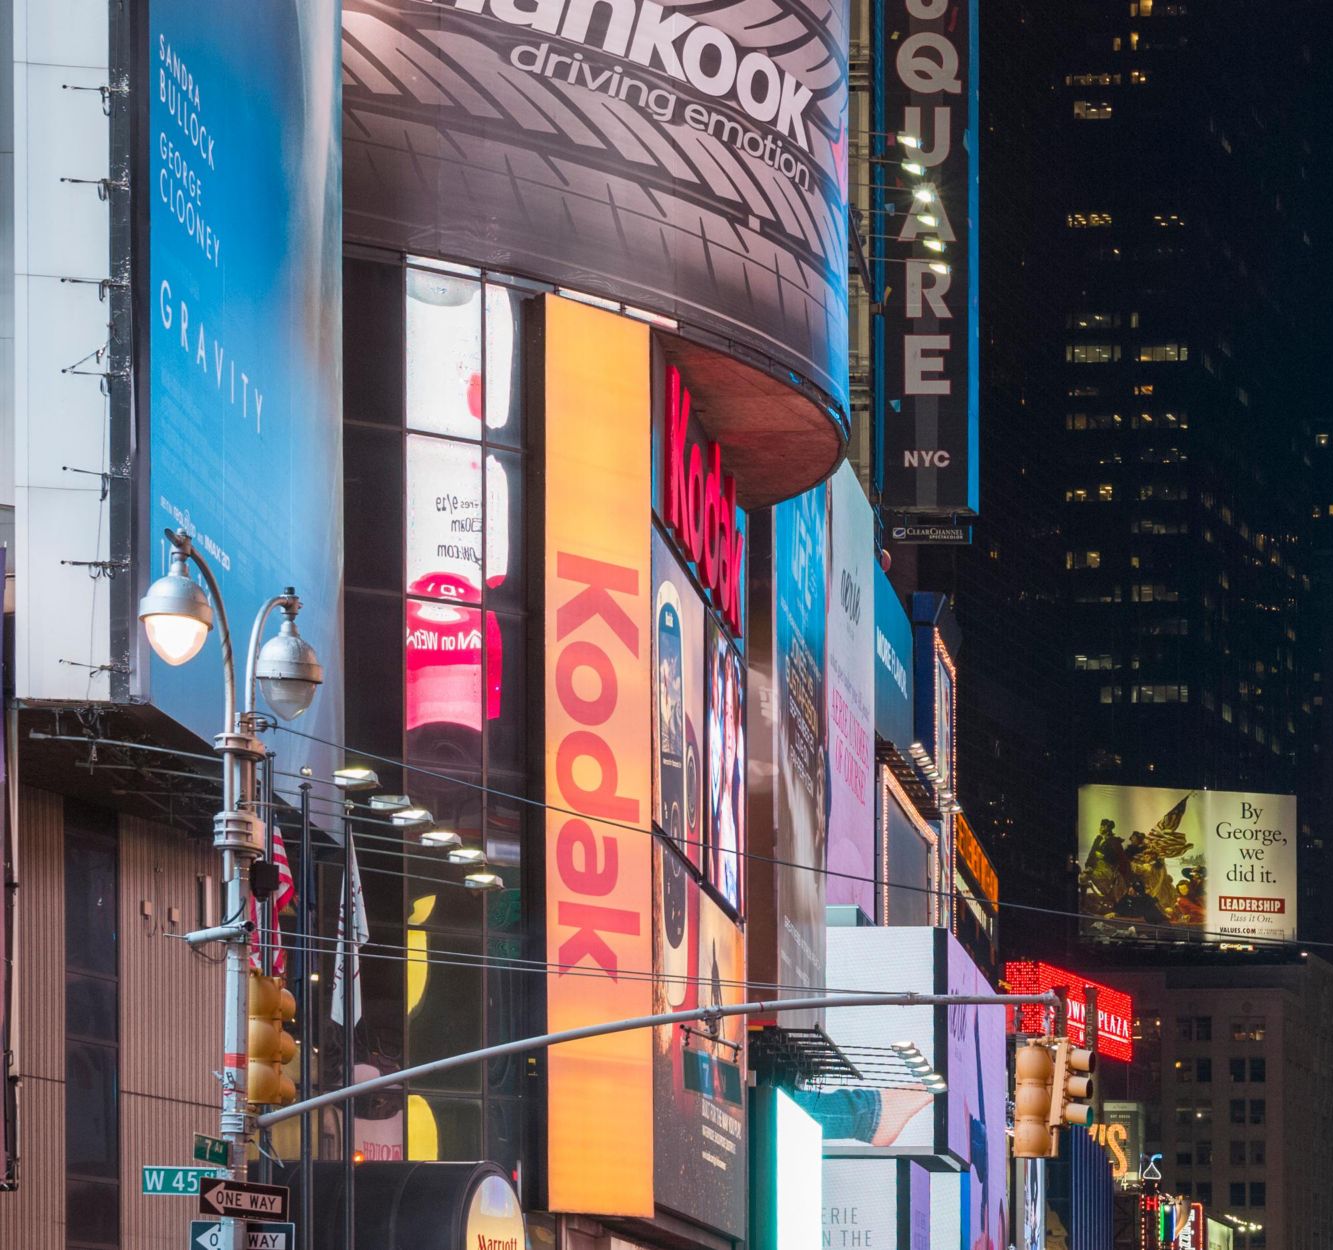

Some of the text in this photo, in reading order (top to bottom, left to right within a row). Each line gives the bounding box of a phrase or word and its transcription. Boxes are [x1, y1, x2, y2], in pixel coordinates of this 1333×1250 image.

[159, 33, 201, 111] SANDRA
[159, 68, 215, 171] BULLOCK
[510, 43, 811, 192] driving emotion
[159, 132, 202, 206] GEORGE
[159, 168, 220, 268] CLOONEY
[160, 279, 263, 434] GRAVITY
[904, 449, 951, 469] NYC
[665, 364, 743, 638] Kodak
[555, 551, 641, 985] Kodak
[1240, 802, 1263, 825] By
[1216, 821, 1288, 847] George,
[1240, 848, 1265, 861] we
[1226, 864, 1277, 884] did it.
[1220, 898, 1281, 912] LEADERSHIP
[1230, 913, 1247, 923] Pass
[1219, 927, 1257, 935] VALUES.COM
[1098, 1009, 1129, 1038] PLAZA
[205, 1139, 212, 1160] 7
[145, 1170, 165, 1191] W
[172, 1171, 198, 1192] 45
[216, 1190, 277, 1211] ONE WAY
[248, 1233, 279, 1248] WAY
[840, 1230, 873, 1247] THE
